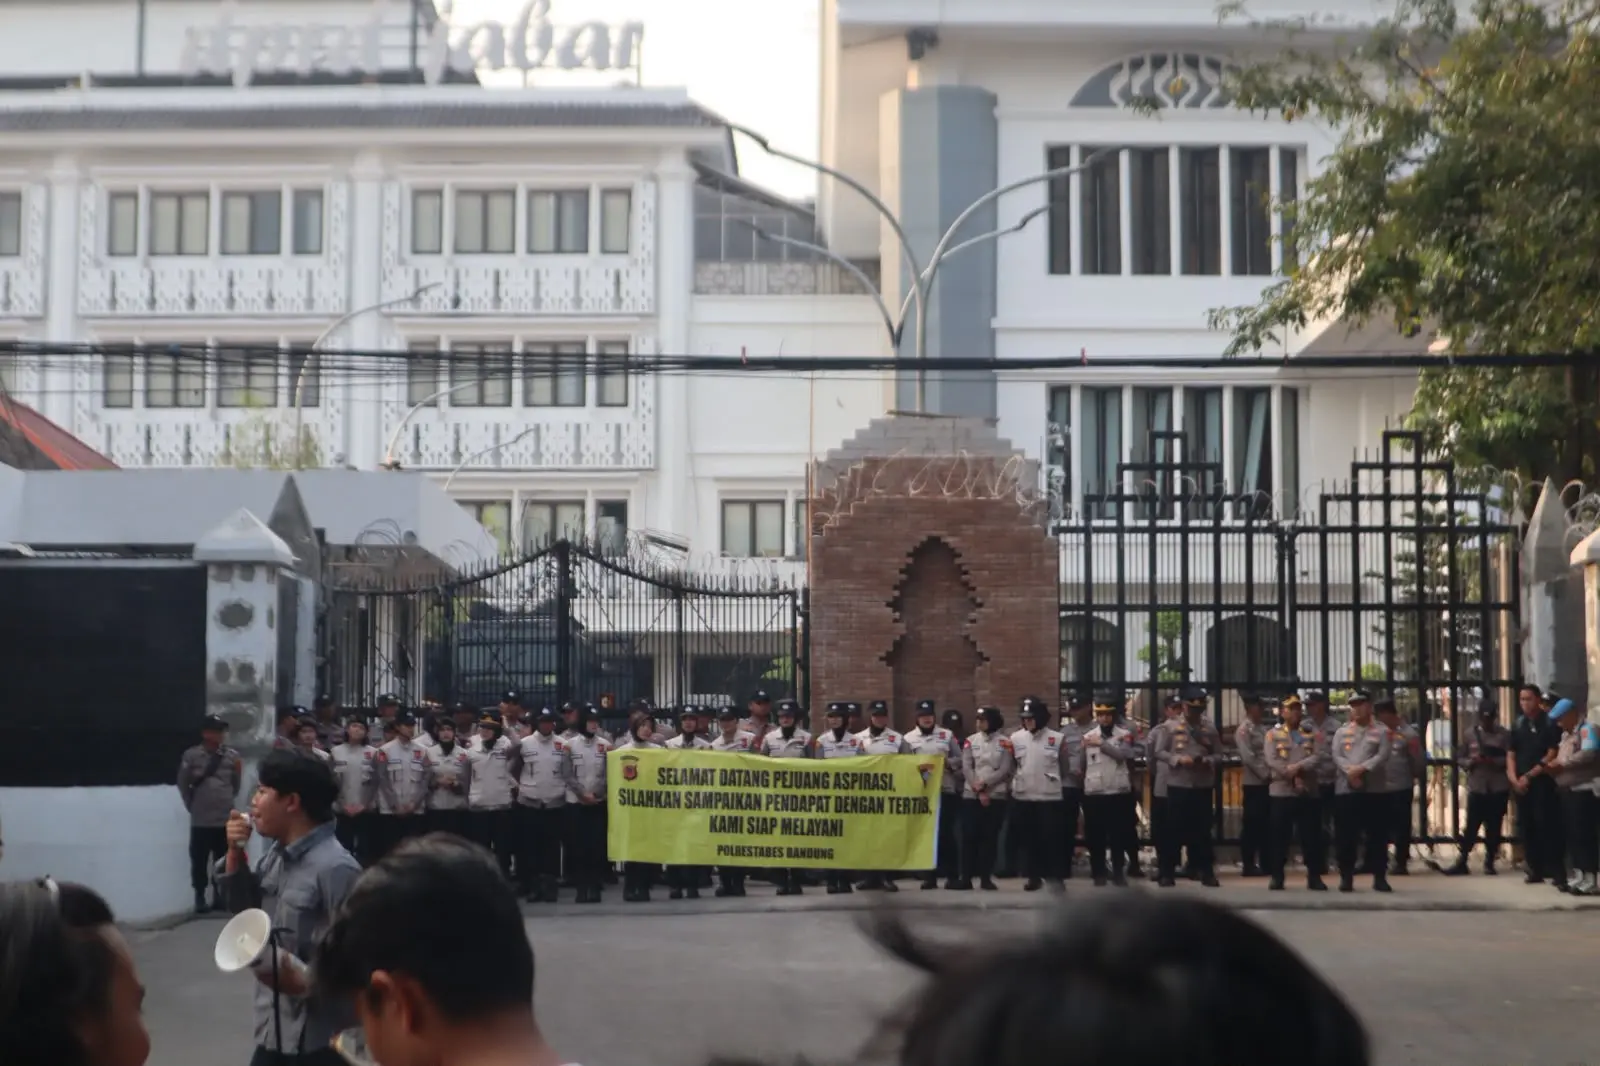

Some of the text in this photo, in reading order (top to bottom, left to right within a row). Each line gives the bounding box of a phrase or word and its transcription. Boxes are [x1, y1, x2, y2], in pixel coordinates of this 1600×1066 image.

[657, 767, 716, 786] SELAMAT
[720, 768, 770, 788] DATANG
[773, 770, 830, 789] PEJUANG
[618, 788, 681, 809] SILAHKAN
[684, 790, 762, 811] SAMPAIKAN
[765, 794, 832, 813] PENDAPAT
[835, 795, 885, 814] DENGAN
[709, 815, 843, 837] KAMI SIAP MELAYANI
[717, 844, 834, 860] POLRESTABES BANDUNG
